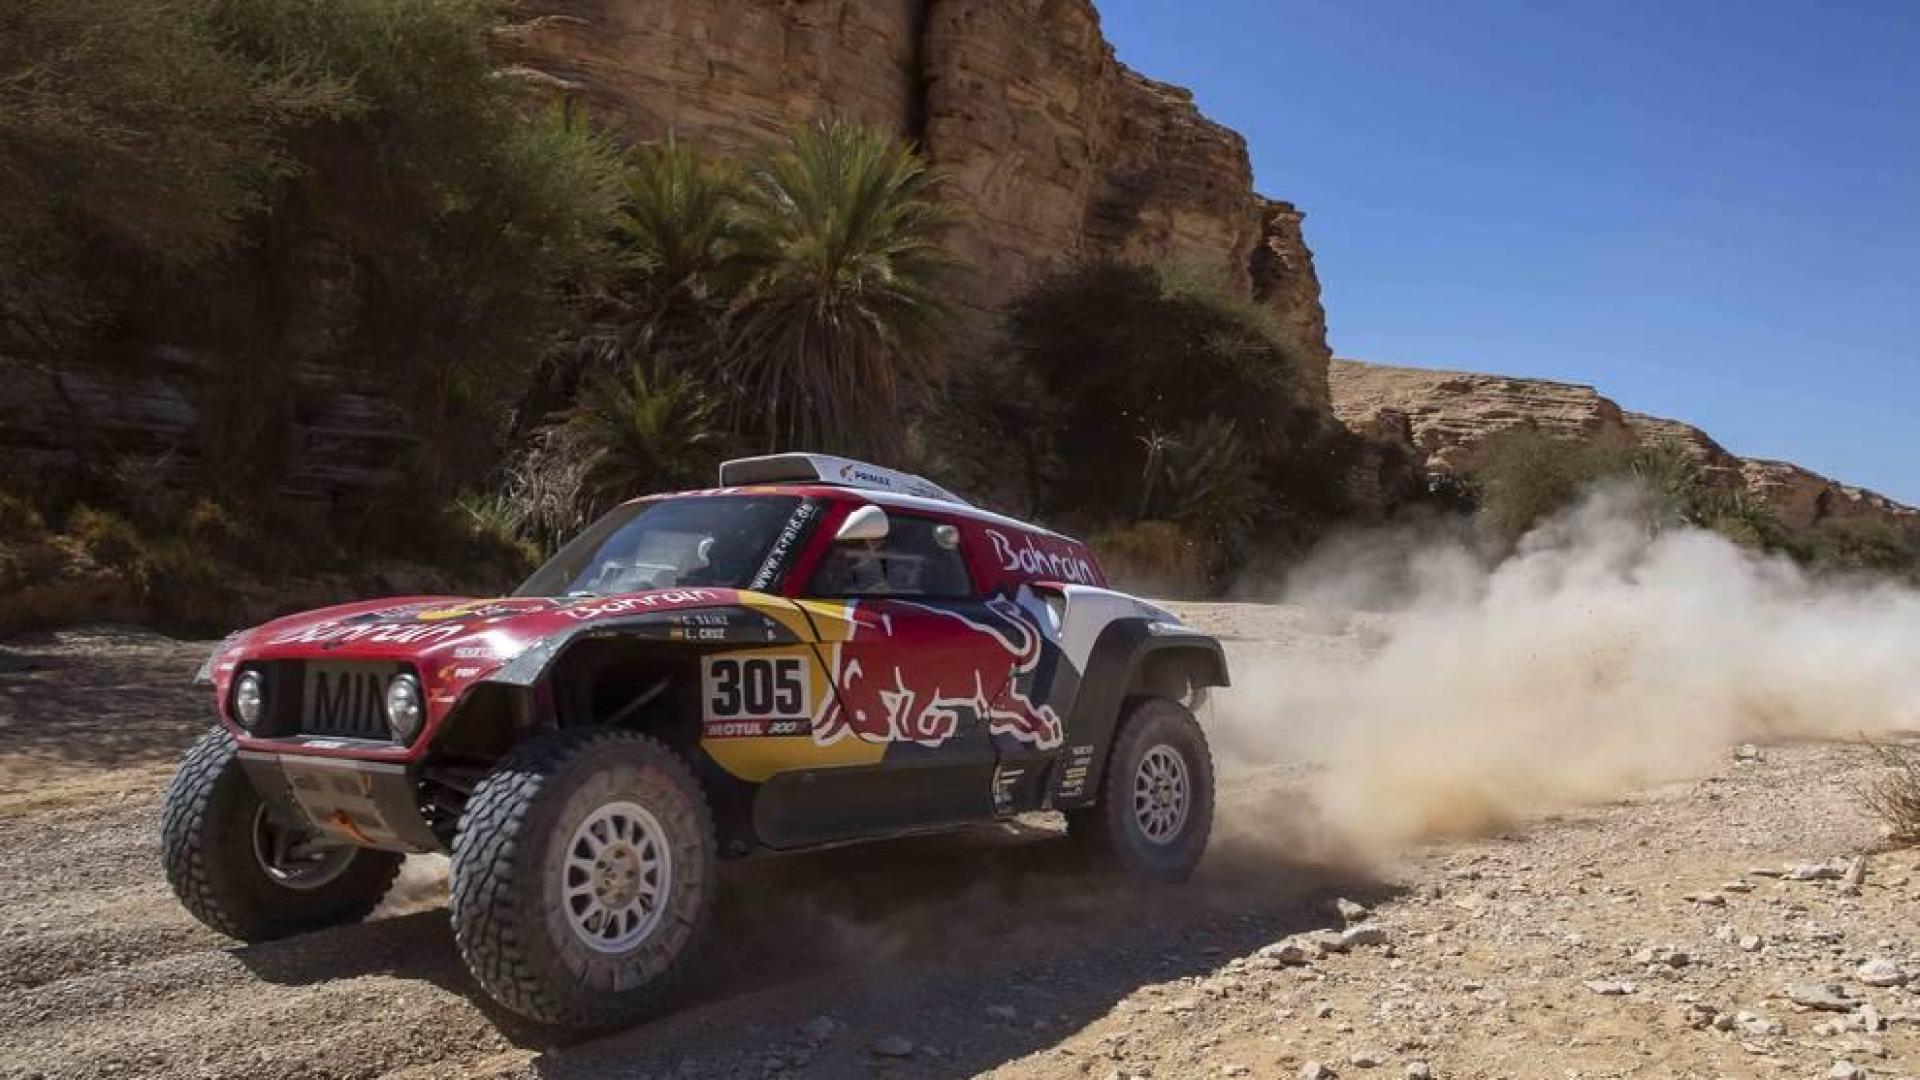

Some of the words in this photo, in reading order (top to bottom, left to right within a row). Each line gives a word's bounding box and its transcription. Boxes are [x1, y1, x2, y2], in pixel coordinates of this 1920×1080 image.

[985, 528, 1097, 585] Bahrain
[313, 671, 396, 733] MIN
[711, 659, 802, 716] 305
[707, 722, 764, 736] MOTUL
